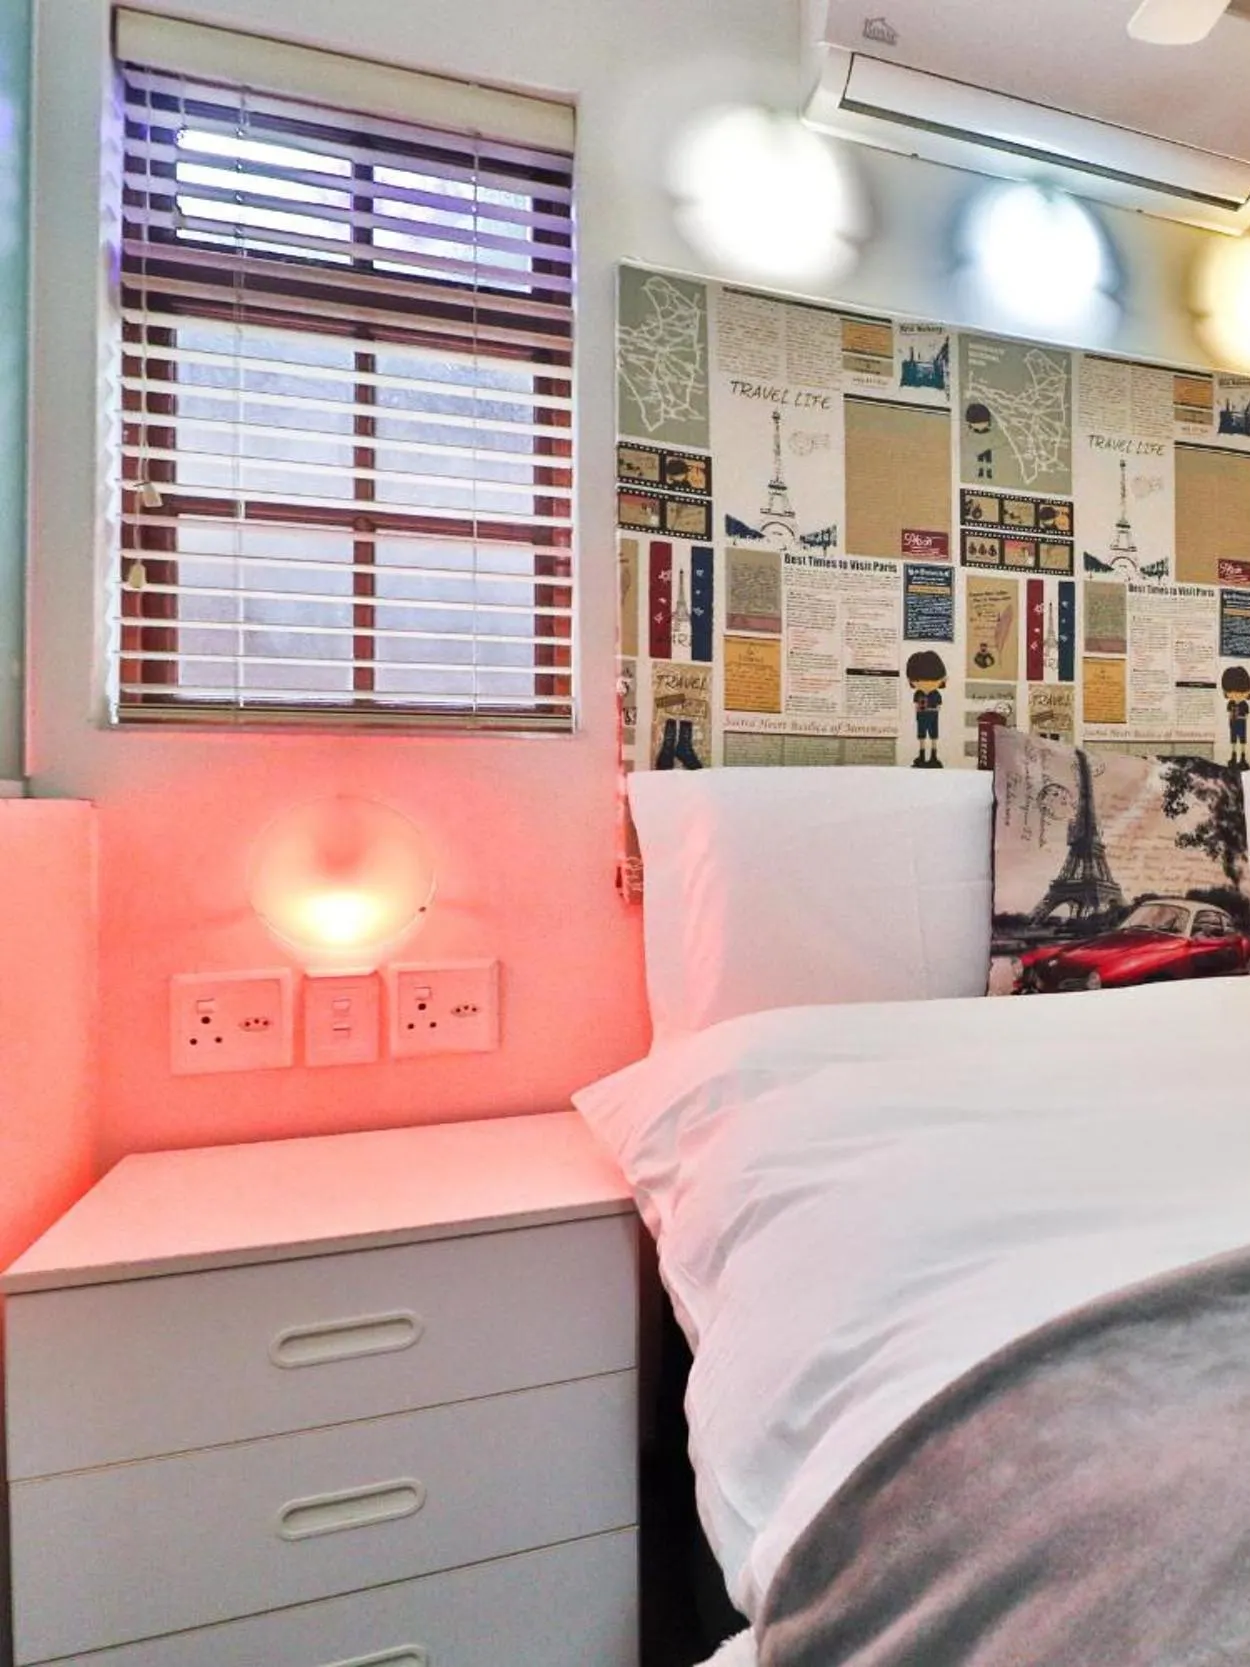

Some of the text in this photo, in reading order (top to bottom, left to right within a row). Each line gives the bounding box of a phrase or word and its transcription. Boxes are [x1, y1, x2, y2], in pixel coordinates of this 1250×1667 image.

[730, 380, 789, 405] TRAVEL
[1088, 433, 1133, 454] TRAVEL
[784, 553, 898, 573] Best Times to Visit Paris
[656, 674, 708, 691] TRAVEL
